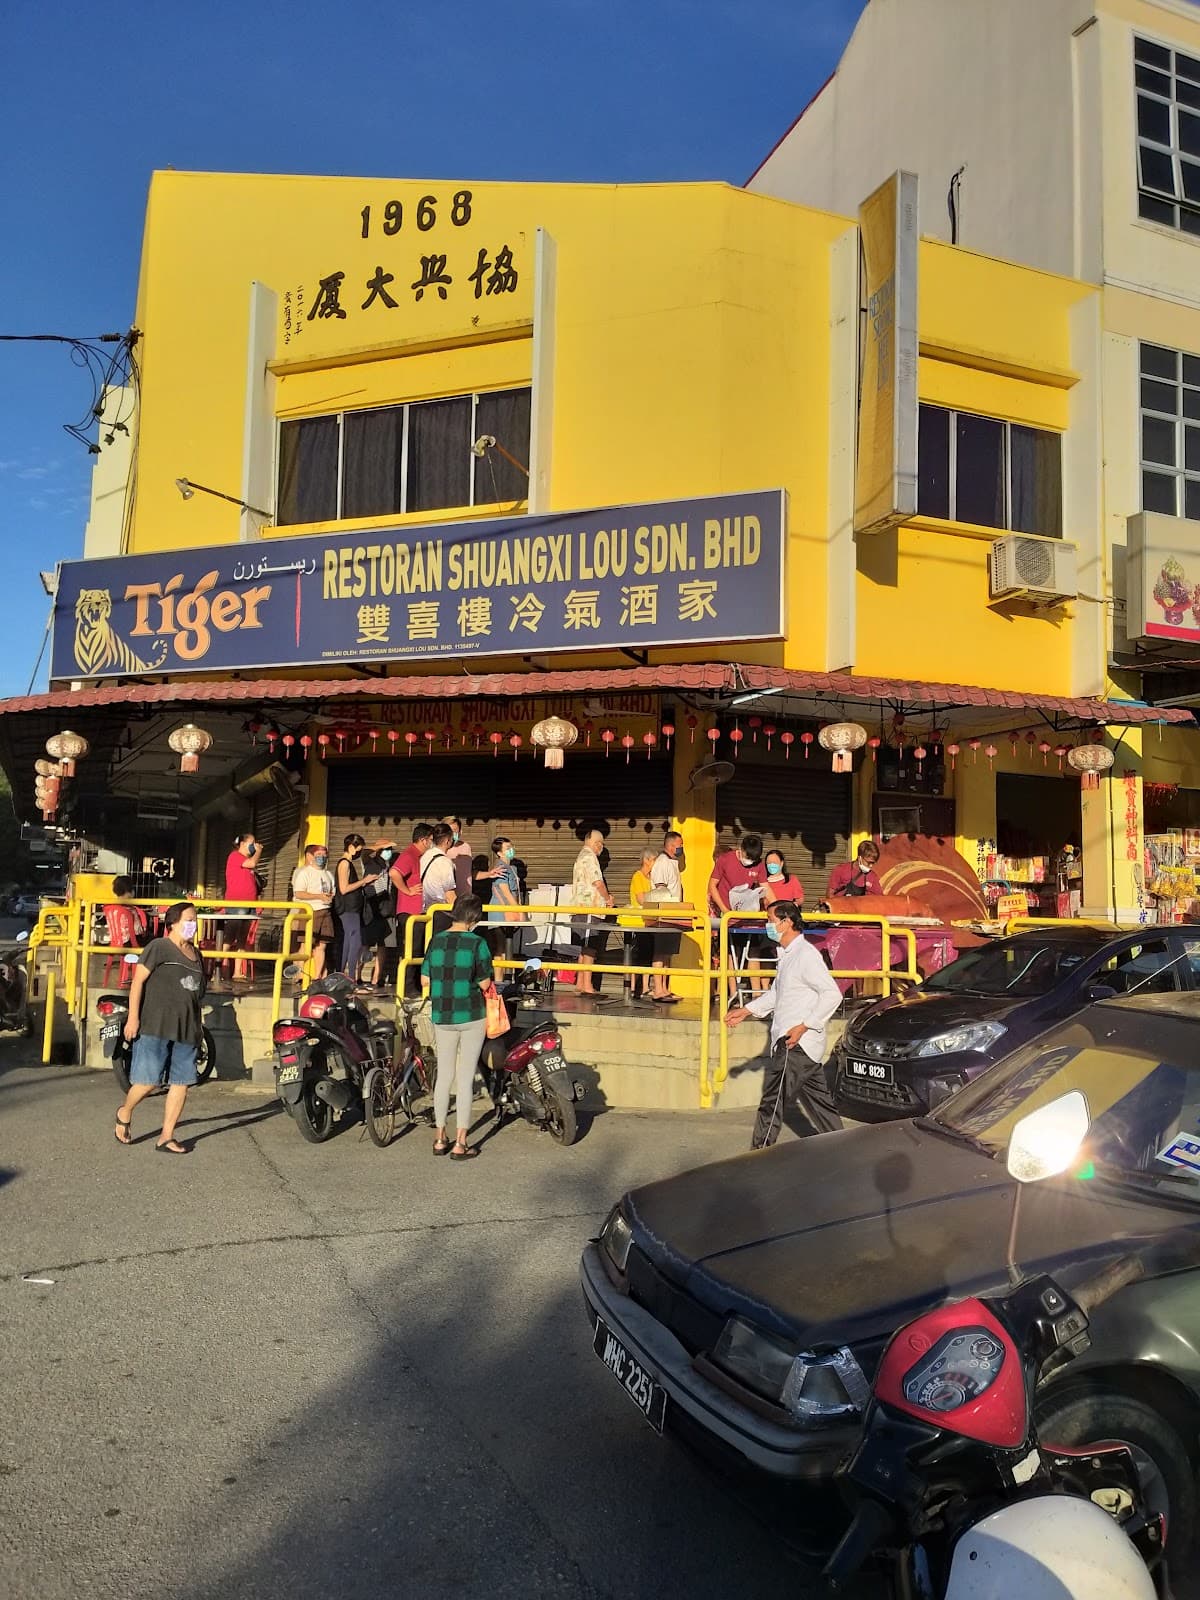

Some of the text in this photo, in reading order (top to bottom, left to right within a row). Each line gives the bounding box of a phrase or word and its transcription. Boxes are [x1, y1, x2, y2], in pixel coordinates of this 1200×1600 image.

[360, 190, 473, 239] 1968
[323, 514, 762, 600] RESTORAN SHUANGXI LOU SDN. BHD
[123, 569, 273, 661] Tiger
[355, 578, 719, 644] 雙喜樓冷氣酒家
[415, 644, 427, 653] LOU
[853, 1062, 886, 1079] RAC 8128
[603, 1333, 654, 1415] WHC 2251
